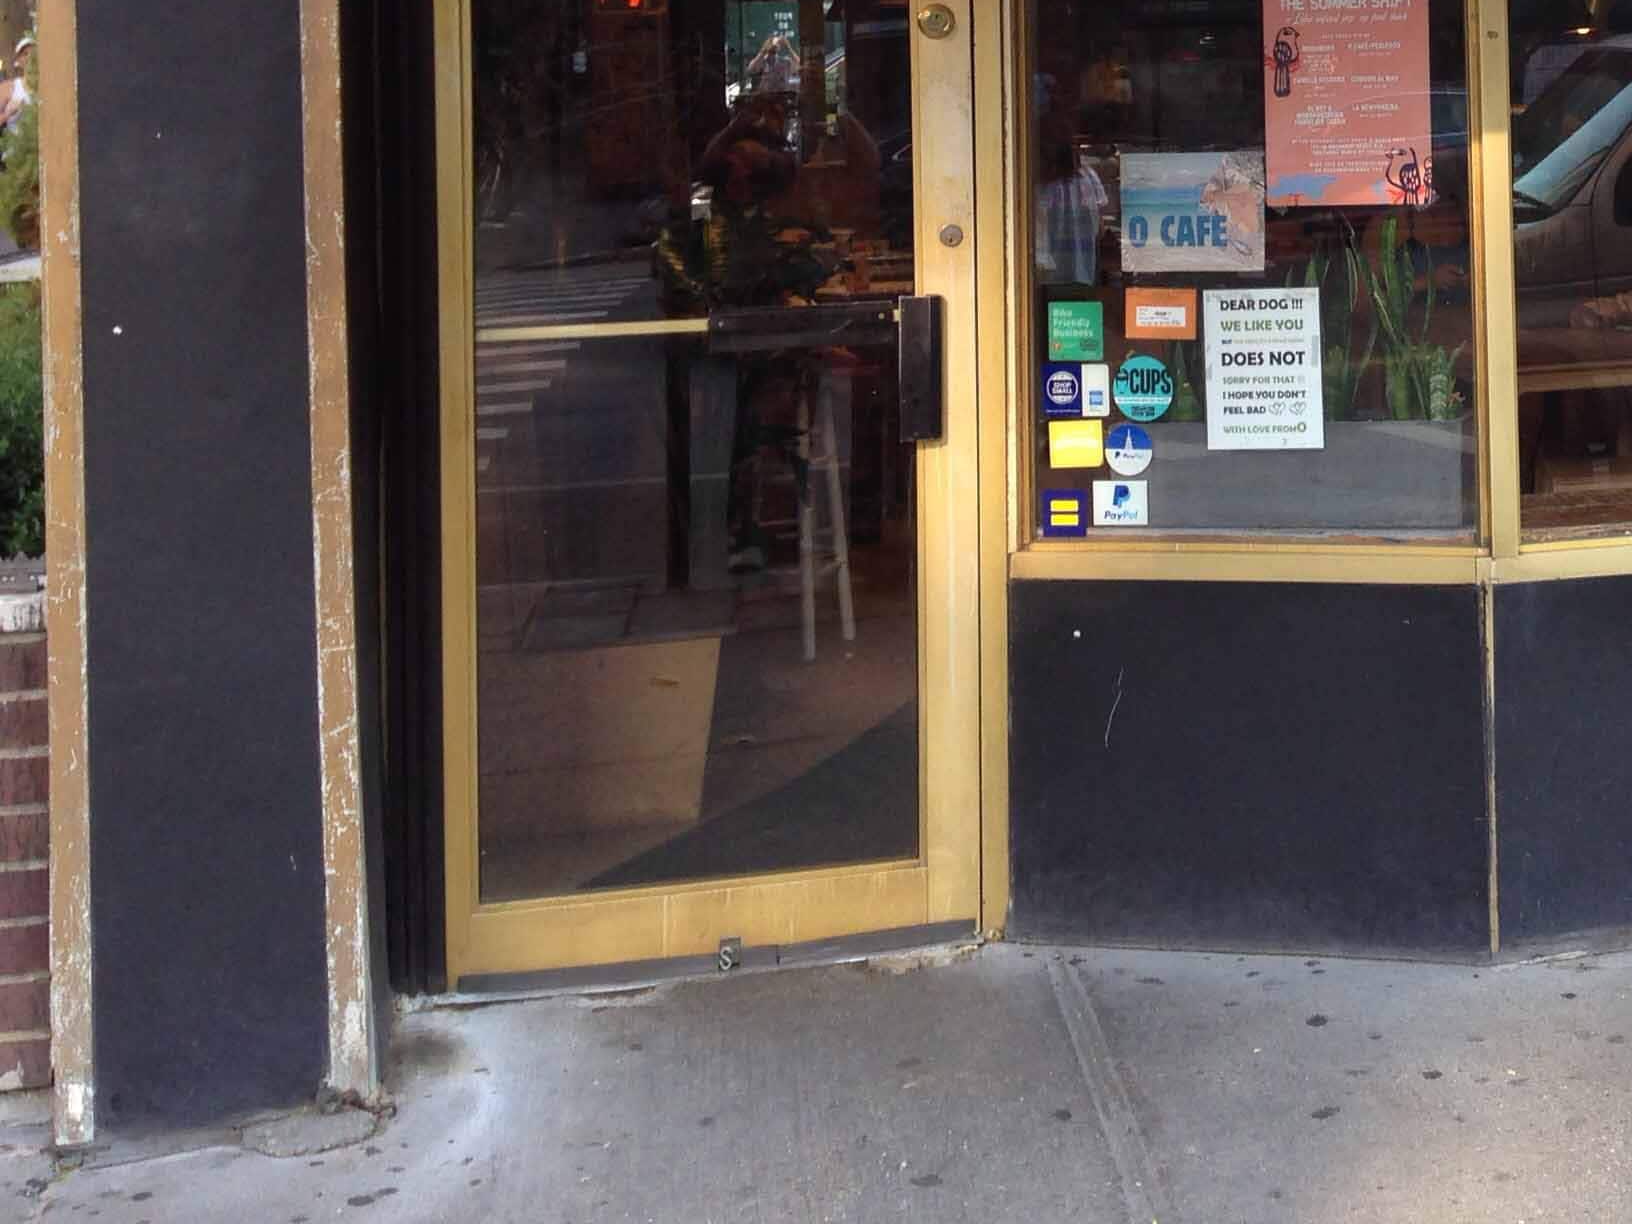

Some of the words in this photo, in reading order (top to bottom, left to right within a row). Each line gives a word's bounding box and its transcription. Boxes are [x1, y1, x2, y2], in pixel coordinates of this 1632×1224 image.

[1129, 216, 1148, 247] O
[1160, 215, 1228, 247] CAFE
[1220, 300, 1255, 311] DEAR
[1259, 298, 1288, 310] DOG
[1220, 321, 1241, 332] WE
[1244, 320, 1272, 331] LIKE
[1275, 319, 1304, 330] YOU
[1221, 352, 1264, 367] DOES
[1269, 350, 1306, 365] NOT
[1129, 368, 1171, 395] CUPS
[1223, 376, 1250, 385] SORRY
[1252, 376, 1270, 384] FOR
[1273, 376, 1295, 384] THAT
[1228, 391, 1254, 400] HOPE
[1256, 390, 1276, 399] YOU
[1278, 390, 1306, 399] DON'T
[1223, 406, 1245, 415] FEEL
[1247, 406, 1267, 414] BAD
[1223, 425, 1246, 433] WITH
[1248, 425, 1270, 433] LOVE
[1272, 425, 1296, 433] FROM
[1104, 511, 1138, 521] PayPal
